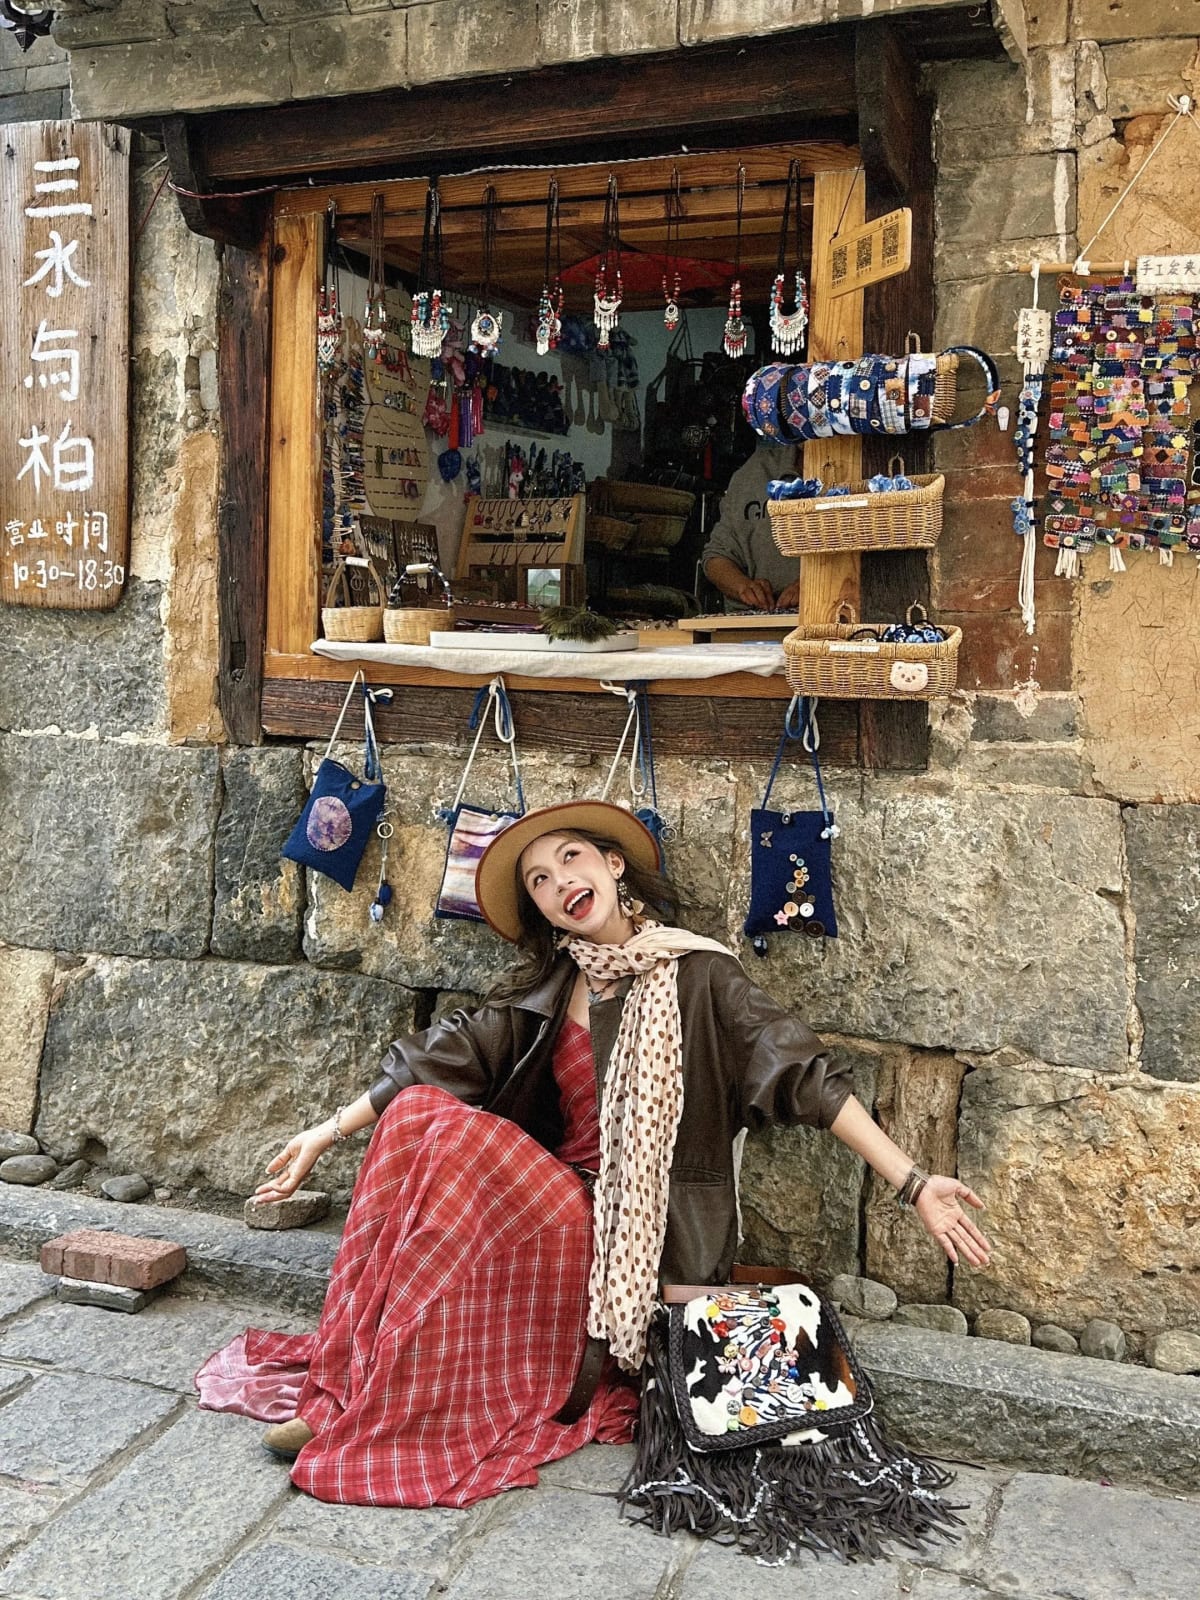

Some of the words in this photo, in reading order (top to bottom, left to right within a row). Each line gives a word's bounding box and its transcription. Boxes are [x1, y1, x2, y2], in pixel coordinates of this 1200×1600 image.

[16, 156, 95, 496] 三水与柏
[5, 510, 108, 553] 营业时间
